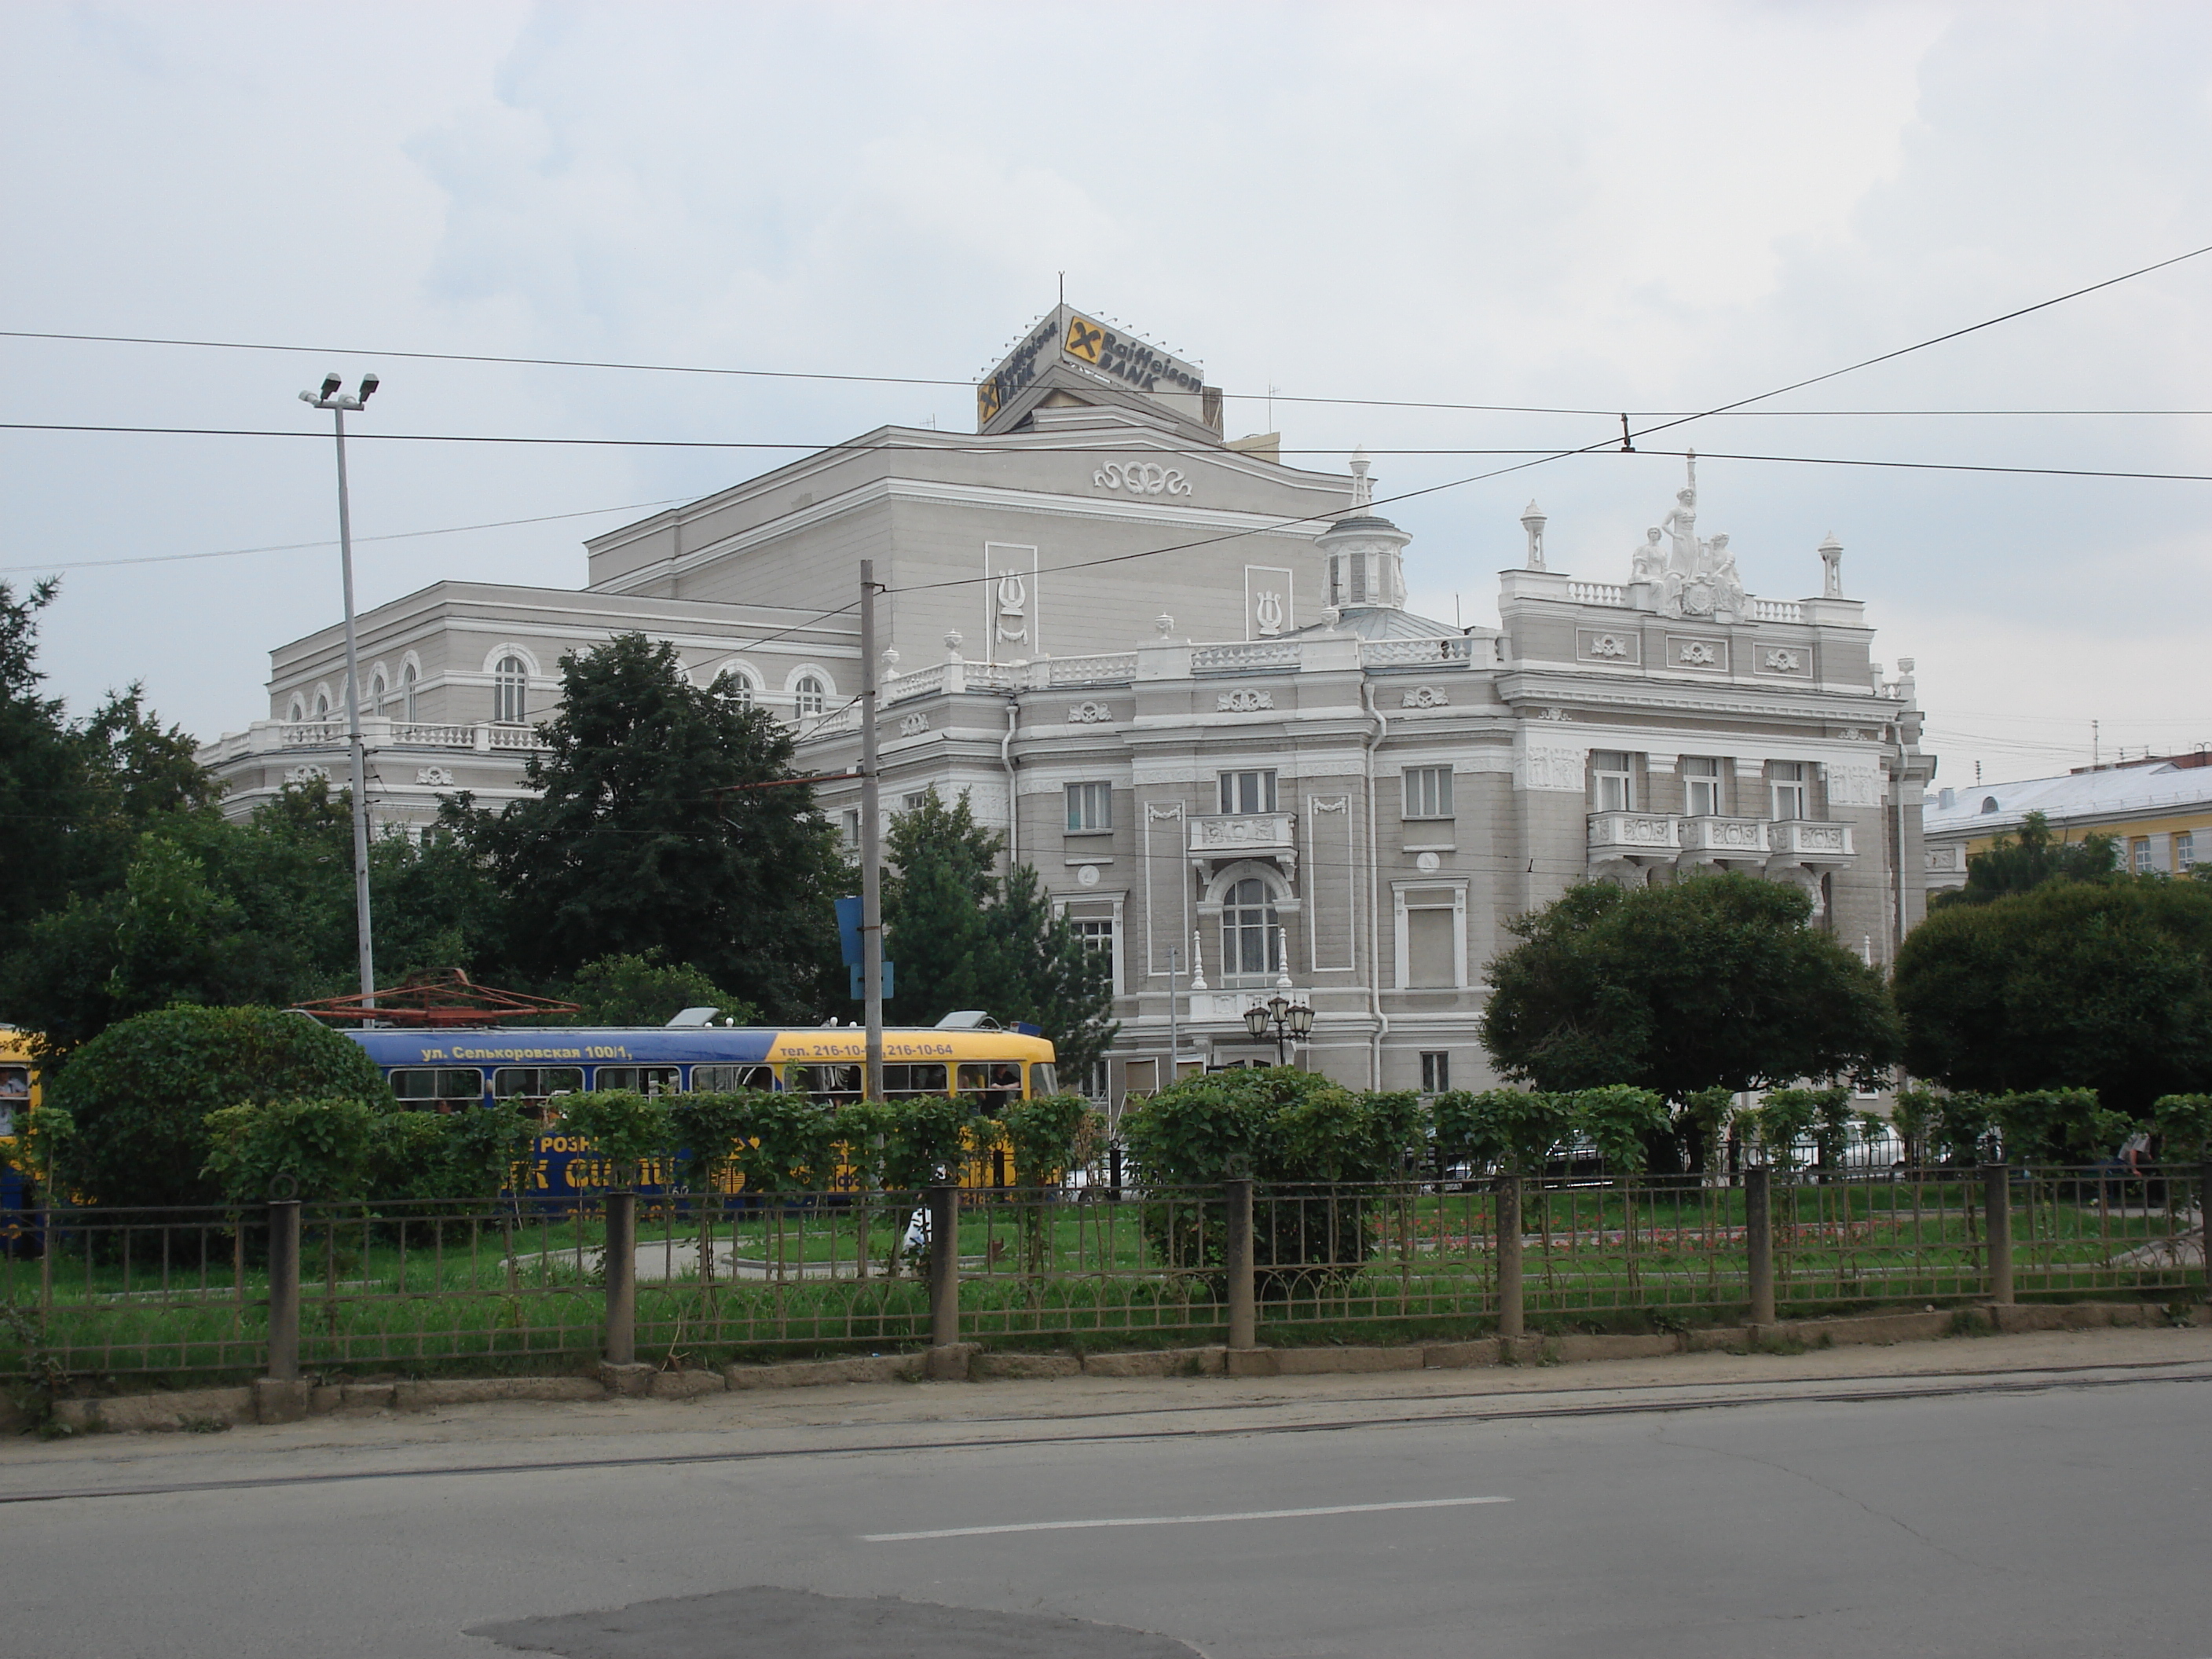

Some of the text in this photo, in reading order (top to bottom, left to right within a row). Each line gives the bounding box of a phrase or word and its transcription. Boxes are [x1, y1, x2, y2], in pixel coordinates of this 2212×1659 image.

[1097, 353, 1160, 392] BANK
[421, 1048, 448, 1062] ул.
[452, 1046, 581, 1061] Селькоровская
[780, 1047, 810, 1057] тел.
